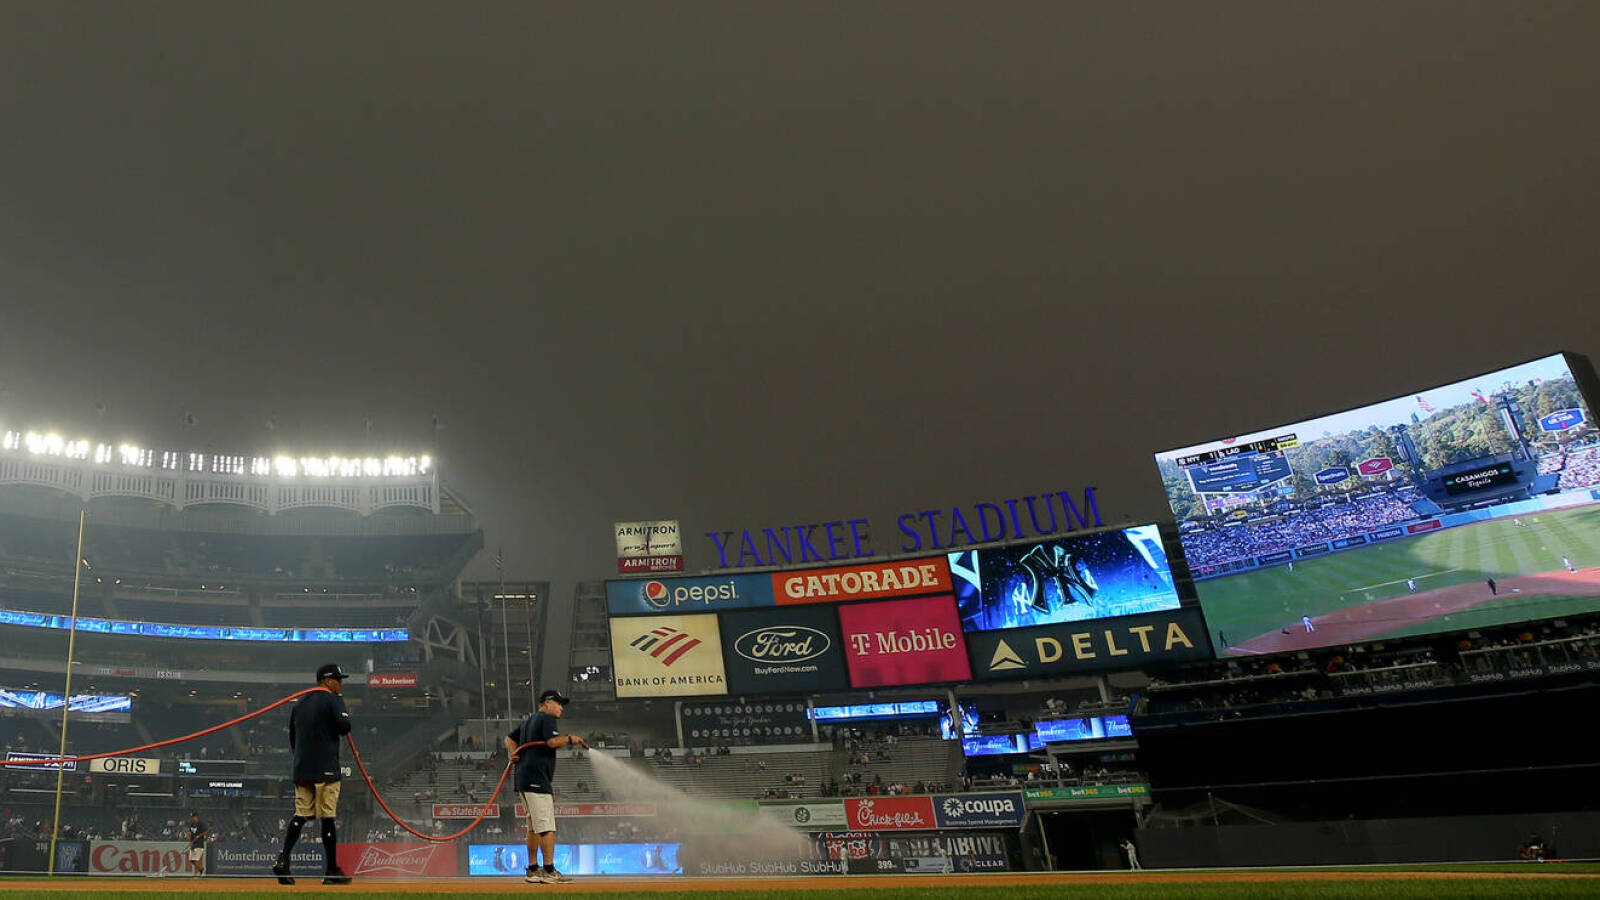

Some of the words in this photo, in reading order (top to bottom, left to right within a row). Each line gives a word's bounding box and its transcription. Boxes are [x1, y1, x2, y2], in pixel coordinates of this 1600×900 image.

[1455, 469, 1499, 484] CASAMIGOS
[1468, 479, 1492, 488] Tequila
[618, 526, 676, 536] ARMITRON
[706, 518, 875, 568] YANKEE
[897, 486, 1104, 552] STADIUM
[624, 558, 677, 567] ARMITRON
[785, 564, 938, 599] GATORADE
[674, 580, 736, 606] pepsi
[752, 632, 813, 657] Ford
[875, 629, 956, 655] Mobile
[1035, 622, 1194, 663] DELTA
[754, 665, 818, 675] BuyFordNow.com
[617, 676, 648, 687] BANK
[652, 676, 666, 686] OF
[669, 674, 724, 685] AMERICA
[103, 758, 146, 773] ORIS
[1117, 786, 1147, 794] bet365
[965, 799, 1015, 817] coupa
[217, 849, 276, 861] Montefiore
[286, 849, 322, 861] nstein
[364, 851, 427, 867] Budweiser
[701, 862, 746, 874] StubHub
[750, 861, 797, 873] StubHub
[975, 860, 1004, 868] CLEAR
